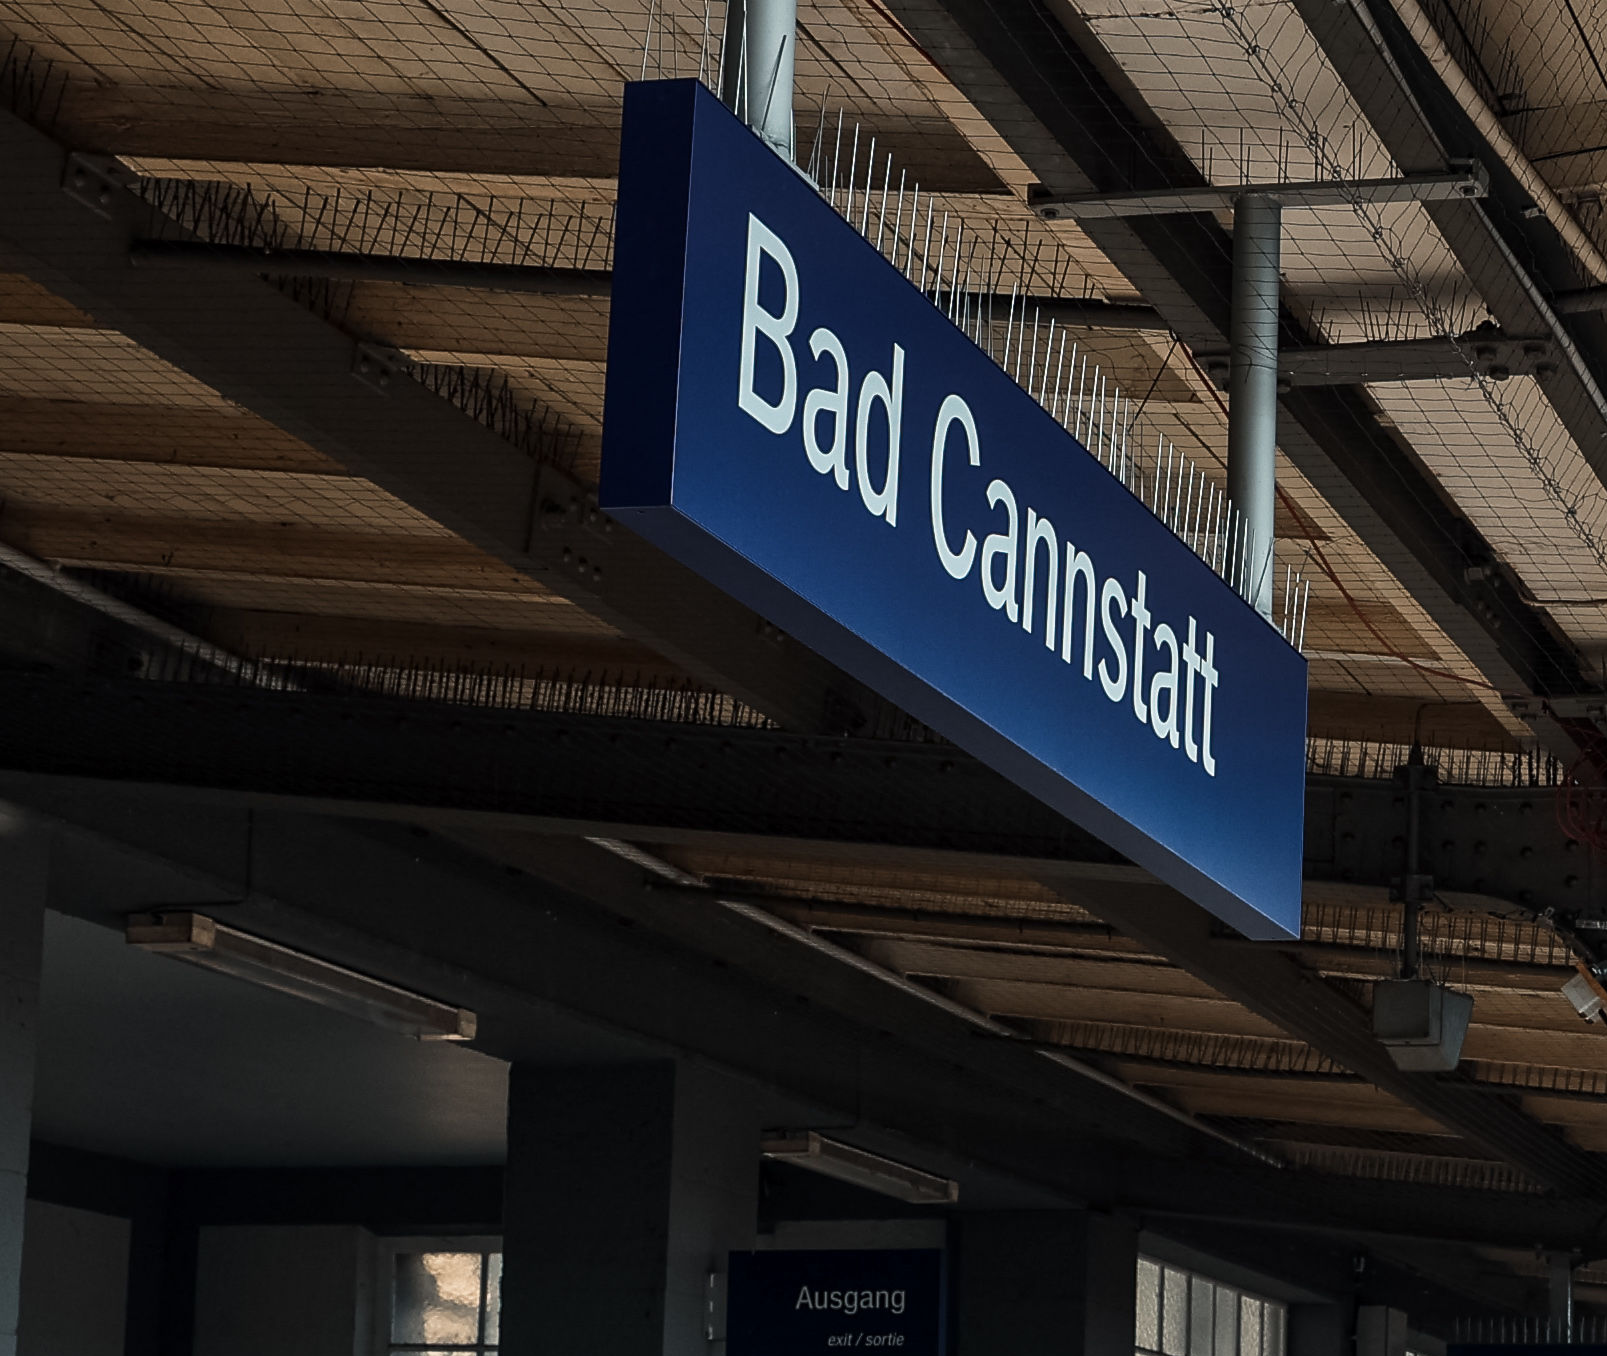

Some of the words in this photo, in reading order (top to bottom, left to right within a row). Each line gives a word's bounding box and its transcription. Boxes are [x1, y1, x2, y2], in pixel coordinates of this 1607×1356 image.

[738, 212, 905, 527] Bad
[931, 394, 1219, 777] Cannstatt
[796, 1286, 906, 1314] Ausgang
[828, 1333, 852, 1346] exit
[855, 1332, 863, 1346] /
[865, 1332, 904, 1346] sortie
